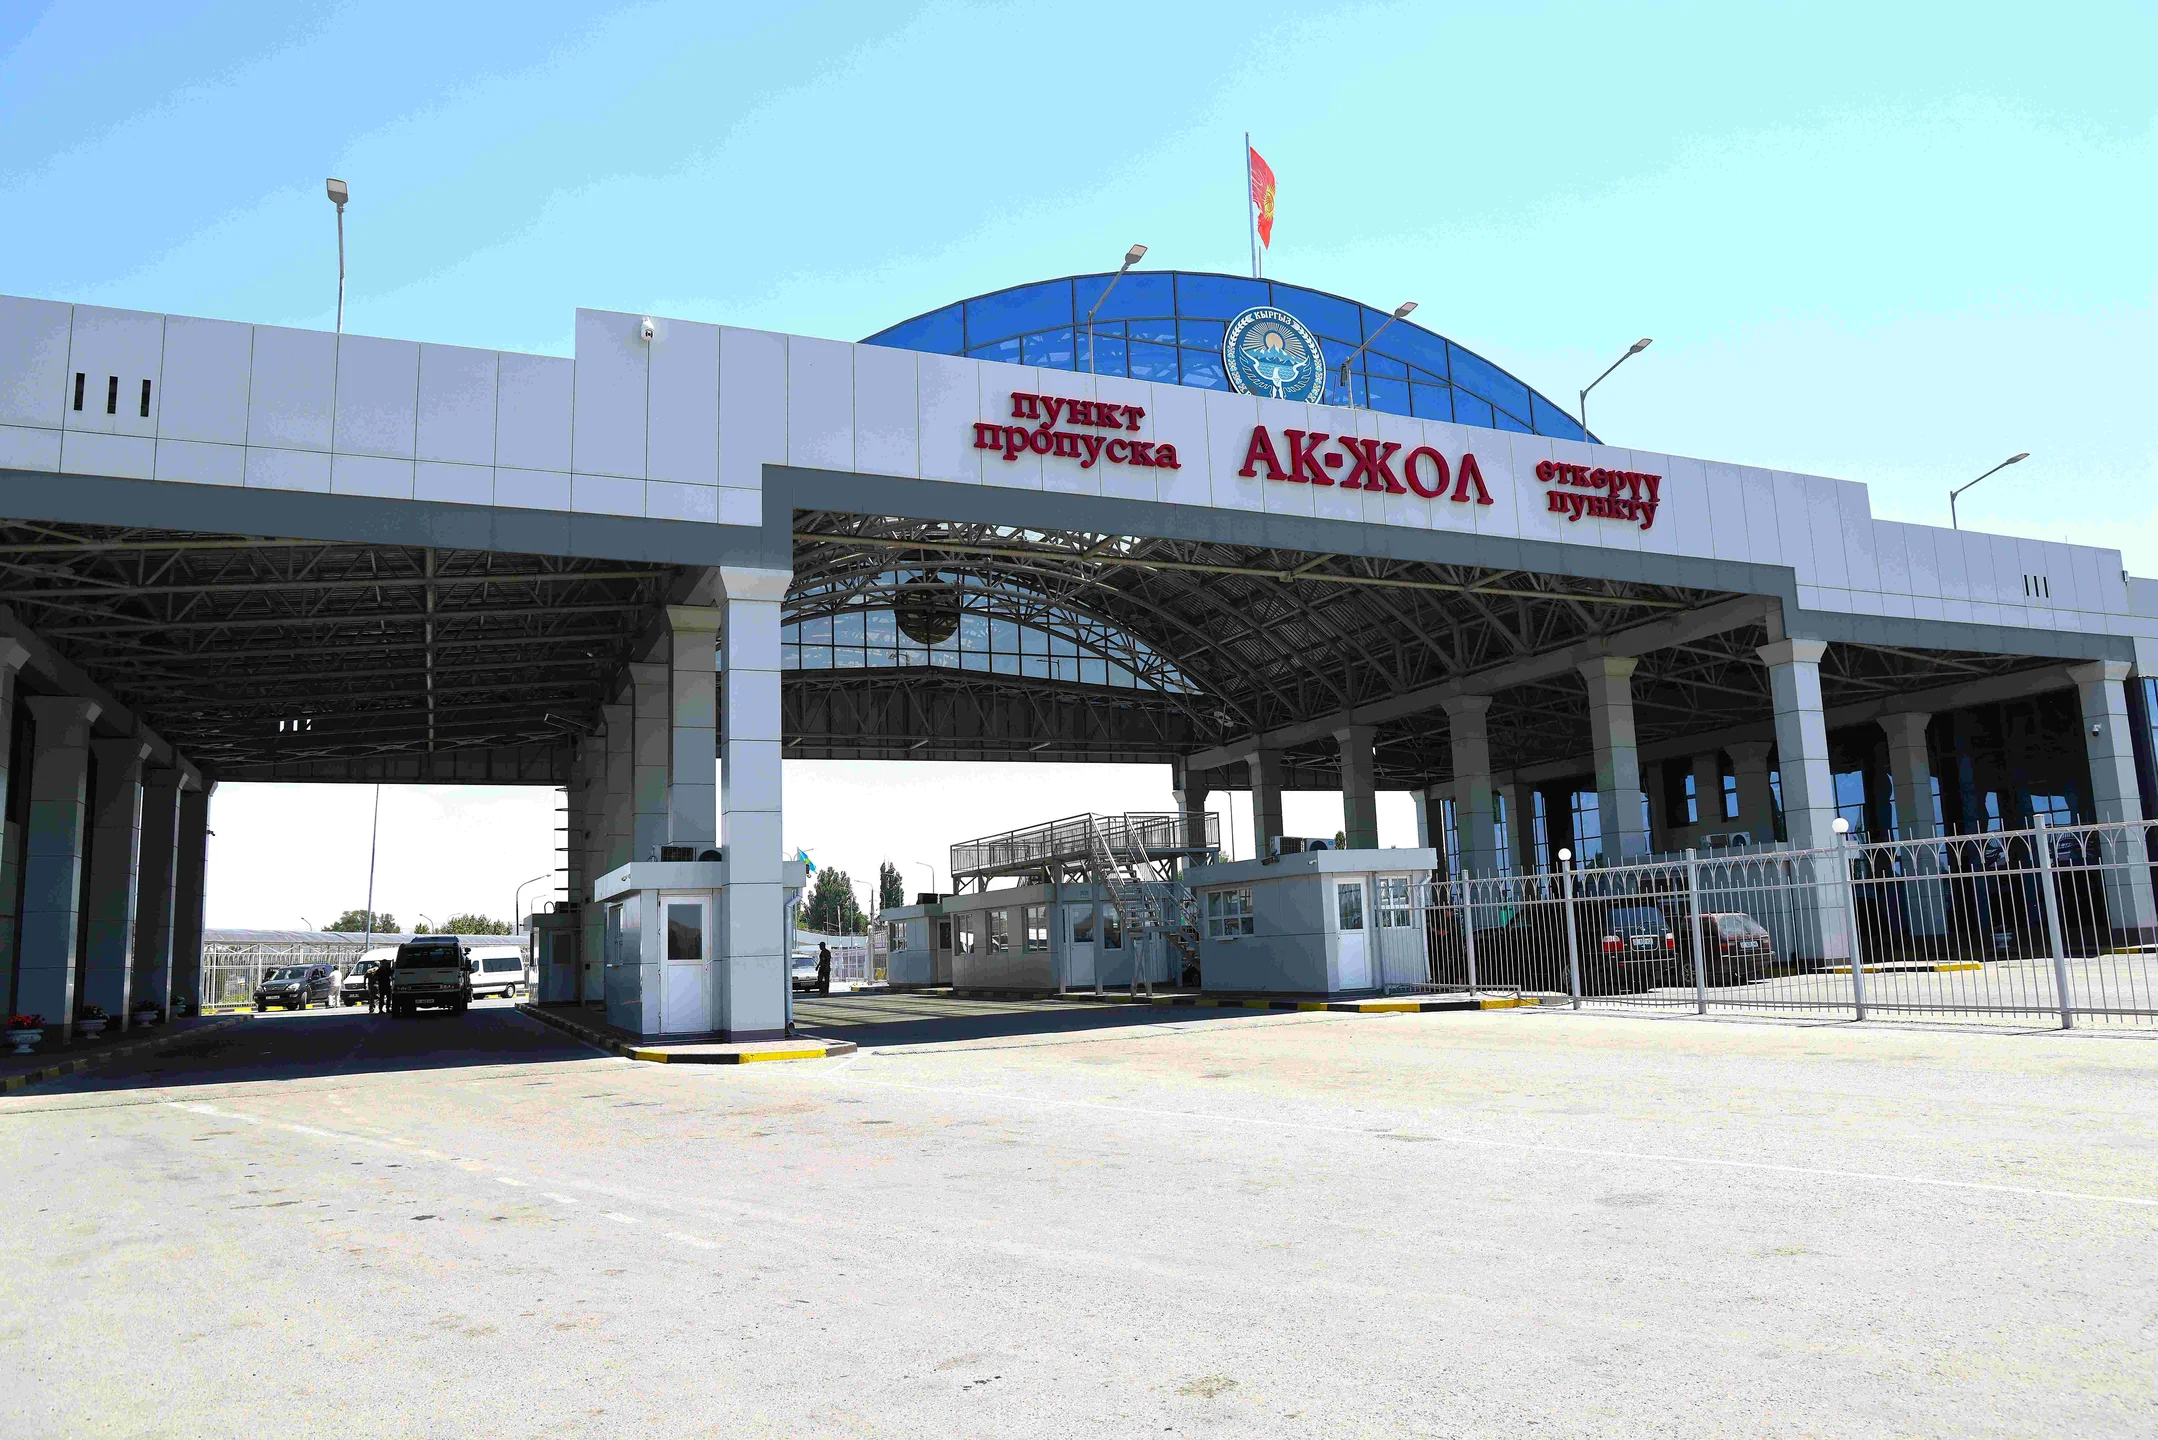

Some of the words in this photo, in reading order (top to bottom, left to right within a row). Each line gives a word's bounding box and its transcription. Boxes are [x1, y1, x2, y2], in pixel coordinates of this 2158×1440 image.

[1253, 310, 1292, 325] КЫРГЫЗ
[1011, 392, 1146, 431] пункт
[973, 422, 1182, 470] пропуска
[1238, 425, 1494, 506] АК-ЖОЛ
[1536, 460, 1662, 502] өткөрүү
[1547, 490, 1659, 530] пункту
